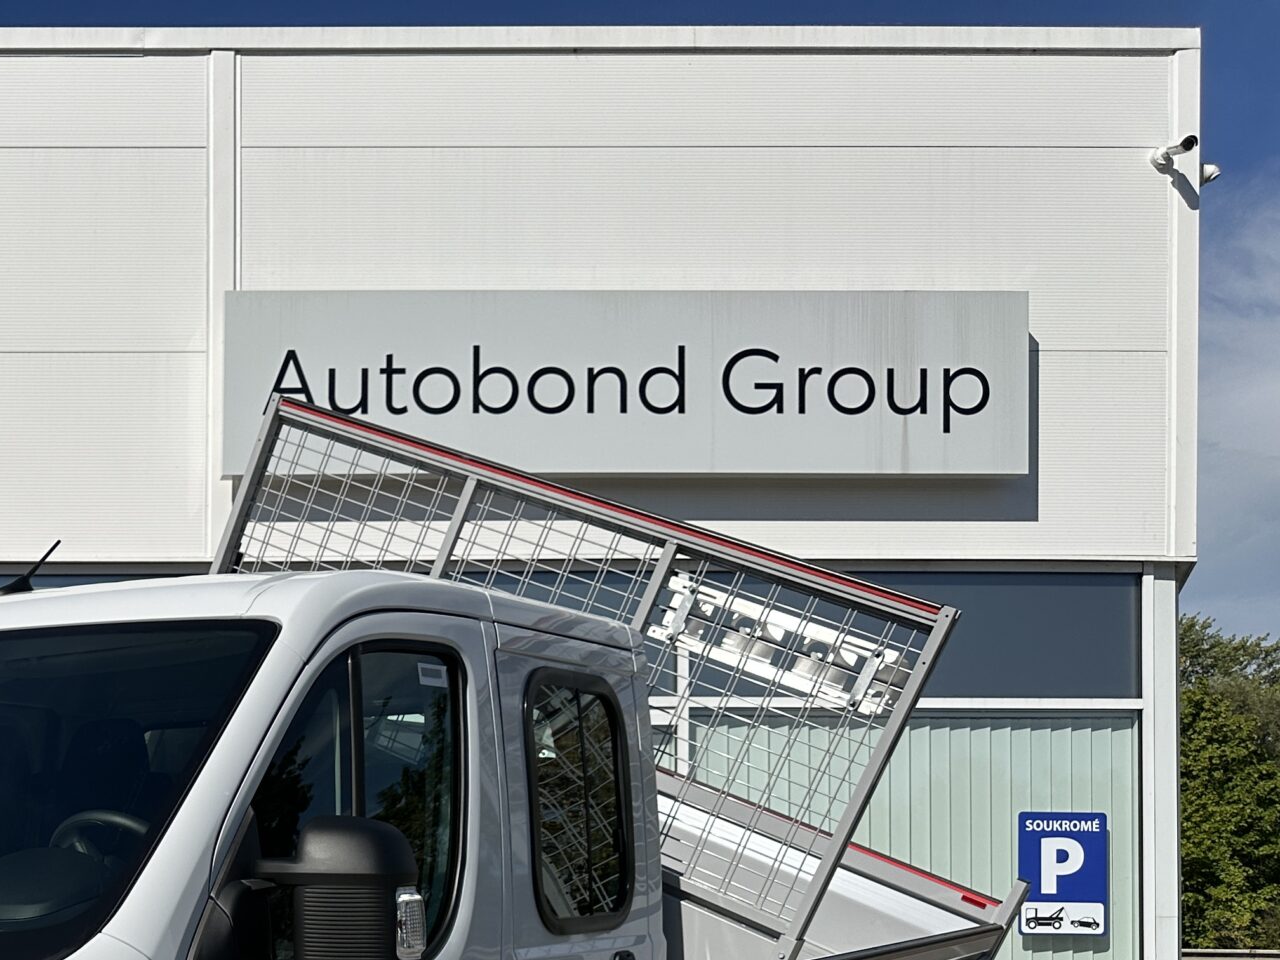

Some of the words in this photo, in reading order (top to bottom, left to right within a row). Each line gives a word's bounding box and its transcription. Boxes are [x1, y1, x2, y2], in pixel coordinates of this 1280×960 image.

[262, 345, 686, 415] Autobond
[722, 348, 990, 434] Group
[1025, 818, 1100, 832] SOUKROMÉ
[1040, 837, 1085, 894] P
